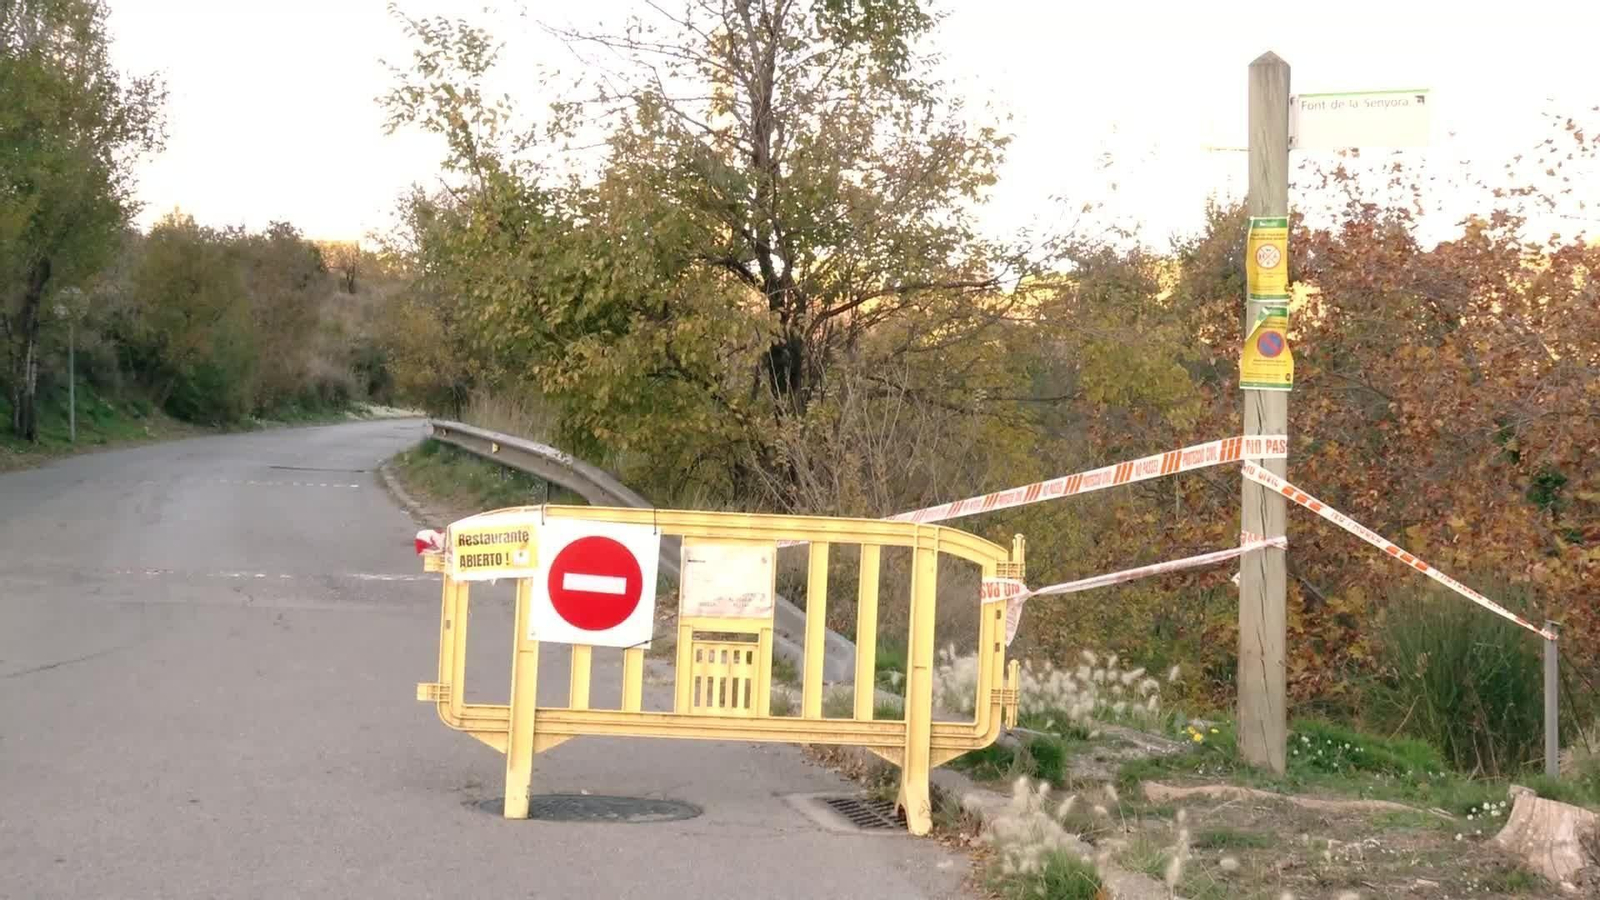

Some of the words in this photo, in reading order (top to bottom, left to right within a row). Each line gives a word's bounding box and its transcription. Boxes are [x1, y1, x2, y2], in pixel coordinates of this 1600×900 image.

[1301, 100, 1325, 111] Font
[1331, 99, 1346, 109] de
[1364, 97, 1410, 110] Senyora
[1245, 439, 1262, 454] NO
[1266, 439, 1286, 454] PAS
[458, 530, 530, 547] Restaurante
[460, 552, 503, 568] ABIERTO
